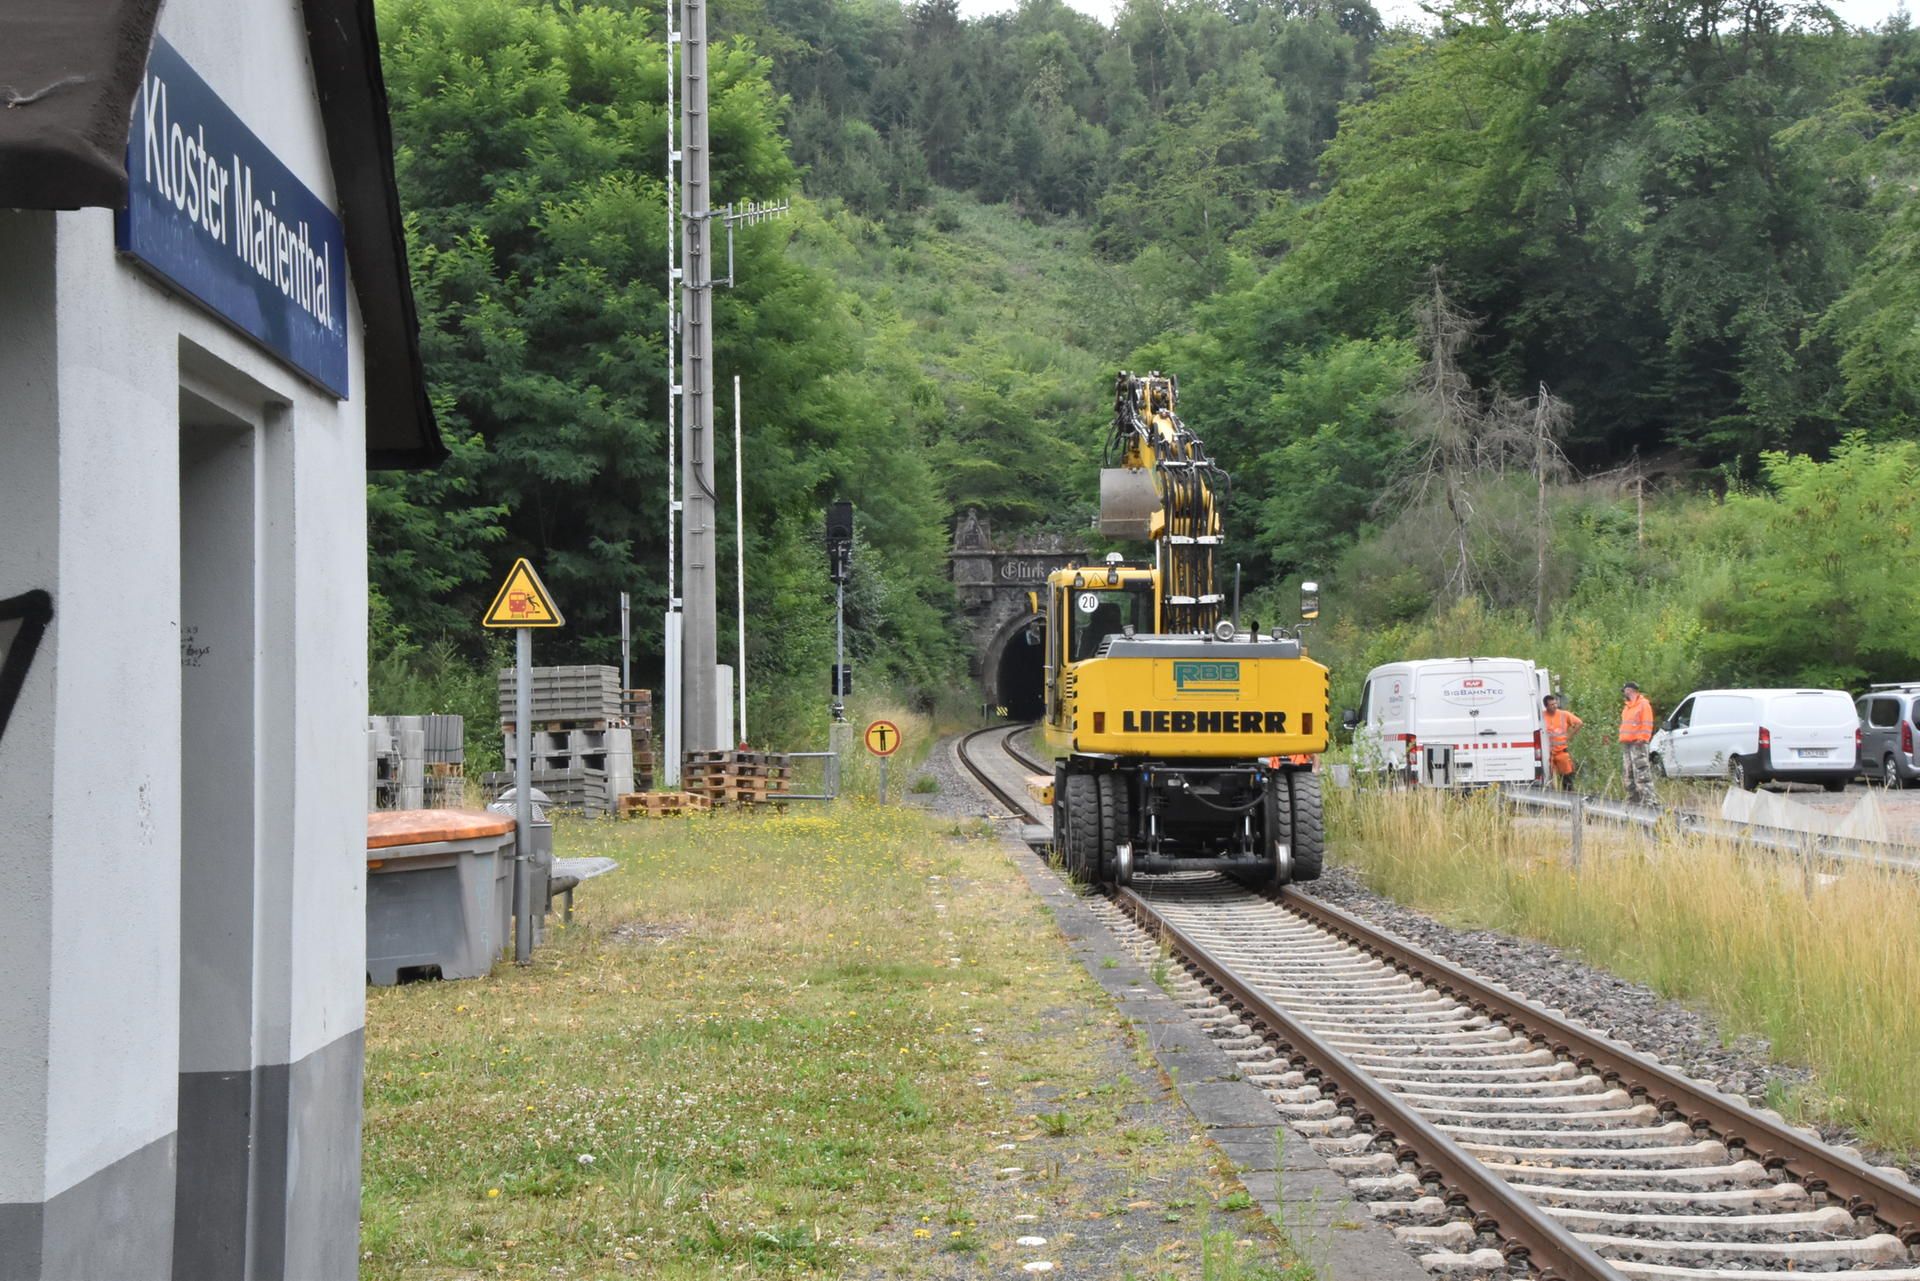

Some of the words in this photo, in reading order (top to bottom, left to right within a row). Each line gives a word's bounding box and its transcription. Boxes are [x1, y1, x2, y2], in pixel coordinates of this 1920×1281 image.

[143, 71, 227, 245] Kloster
[234, 154, 333, 330] Marienthal
[1082, 596, 1095, 608] 20
[1175, 664, 1239, 688] RBB
[1123, 711, 1287, 733] LIEBHERR
